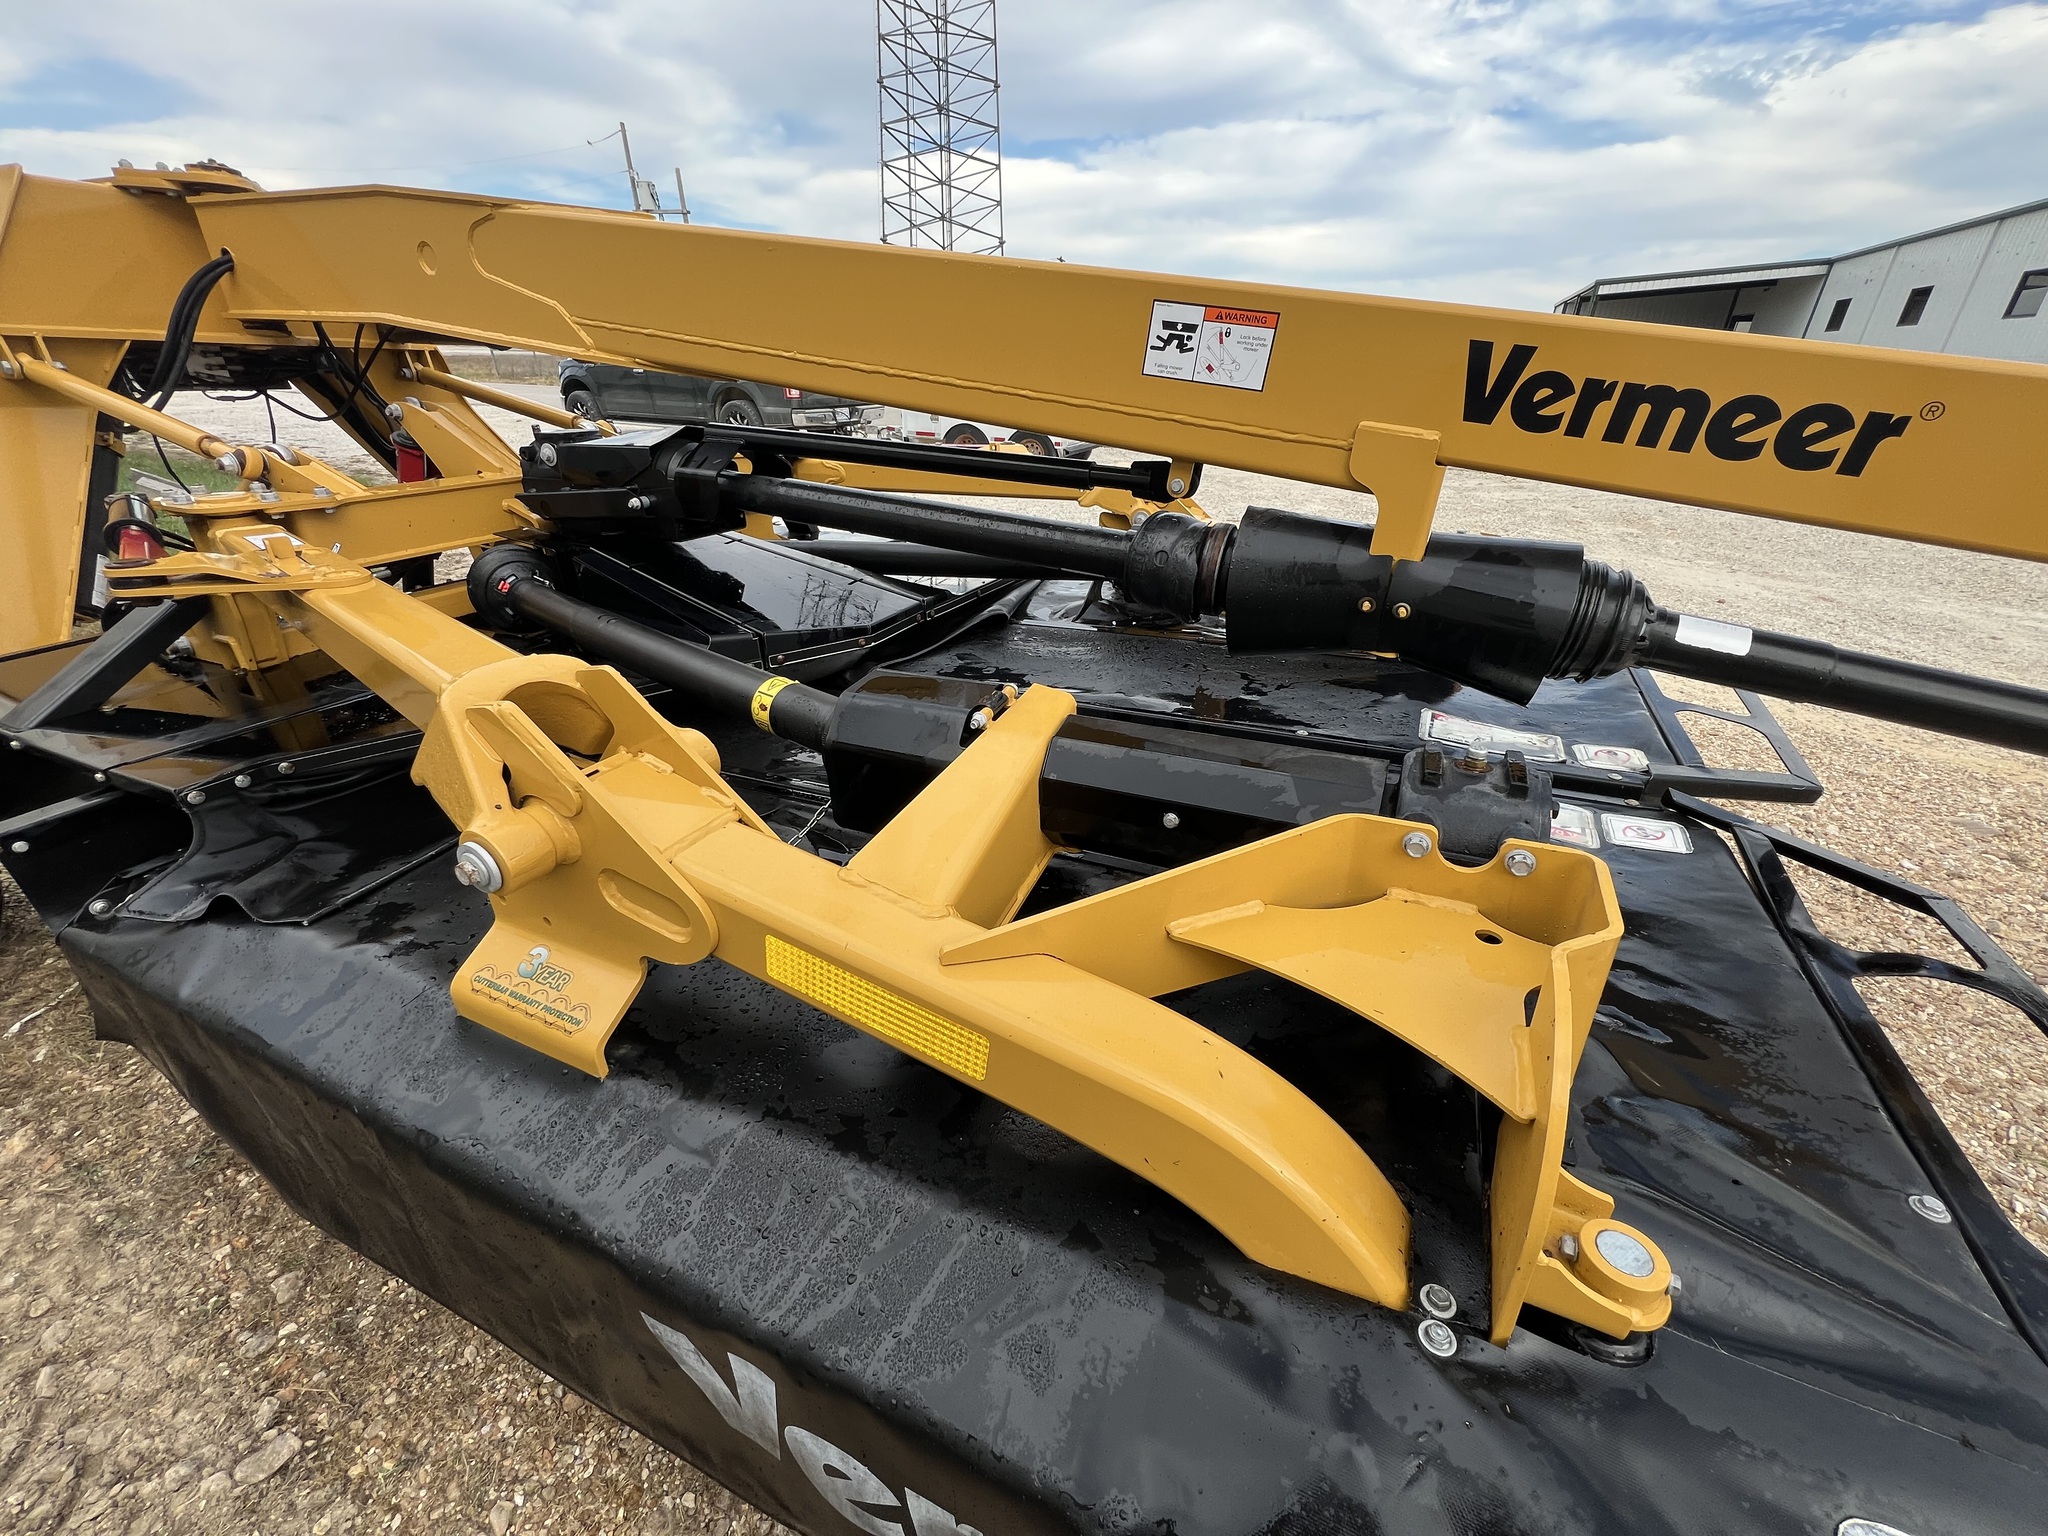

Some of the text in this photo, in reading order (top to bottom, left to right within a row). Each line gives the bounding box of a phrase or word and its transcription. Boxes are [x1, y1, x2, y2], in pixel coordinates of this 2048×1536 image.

[1225, 311, 1268, 325] WARNING
[1237, 340, 1254, 348] working
[1154, 362, 1168, 370] Falling
[1462, 339, 1913, 478] Vermeer
[517, 944, 573, 993] 3 YEAR
[474, 974, 584, 1028] CUTTERBAR WARRANTY PROTECTION
